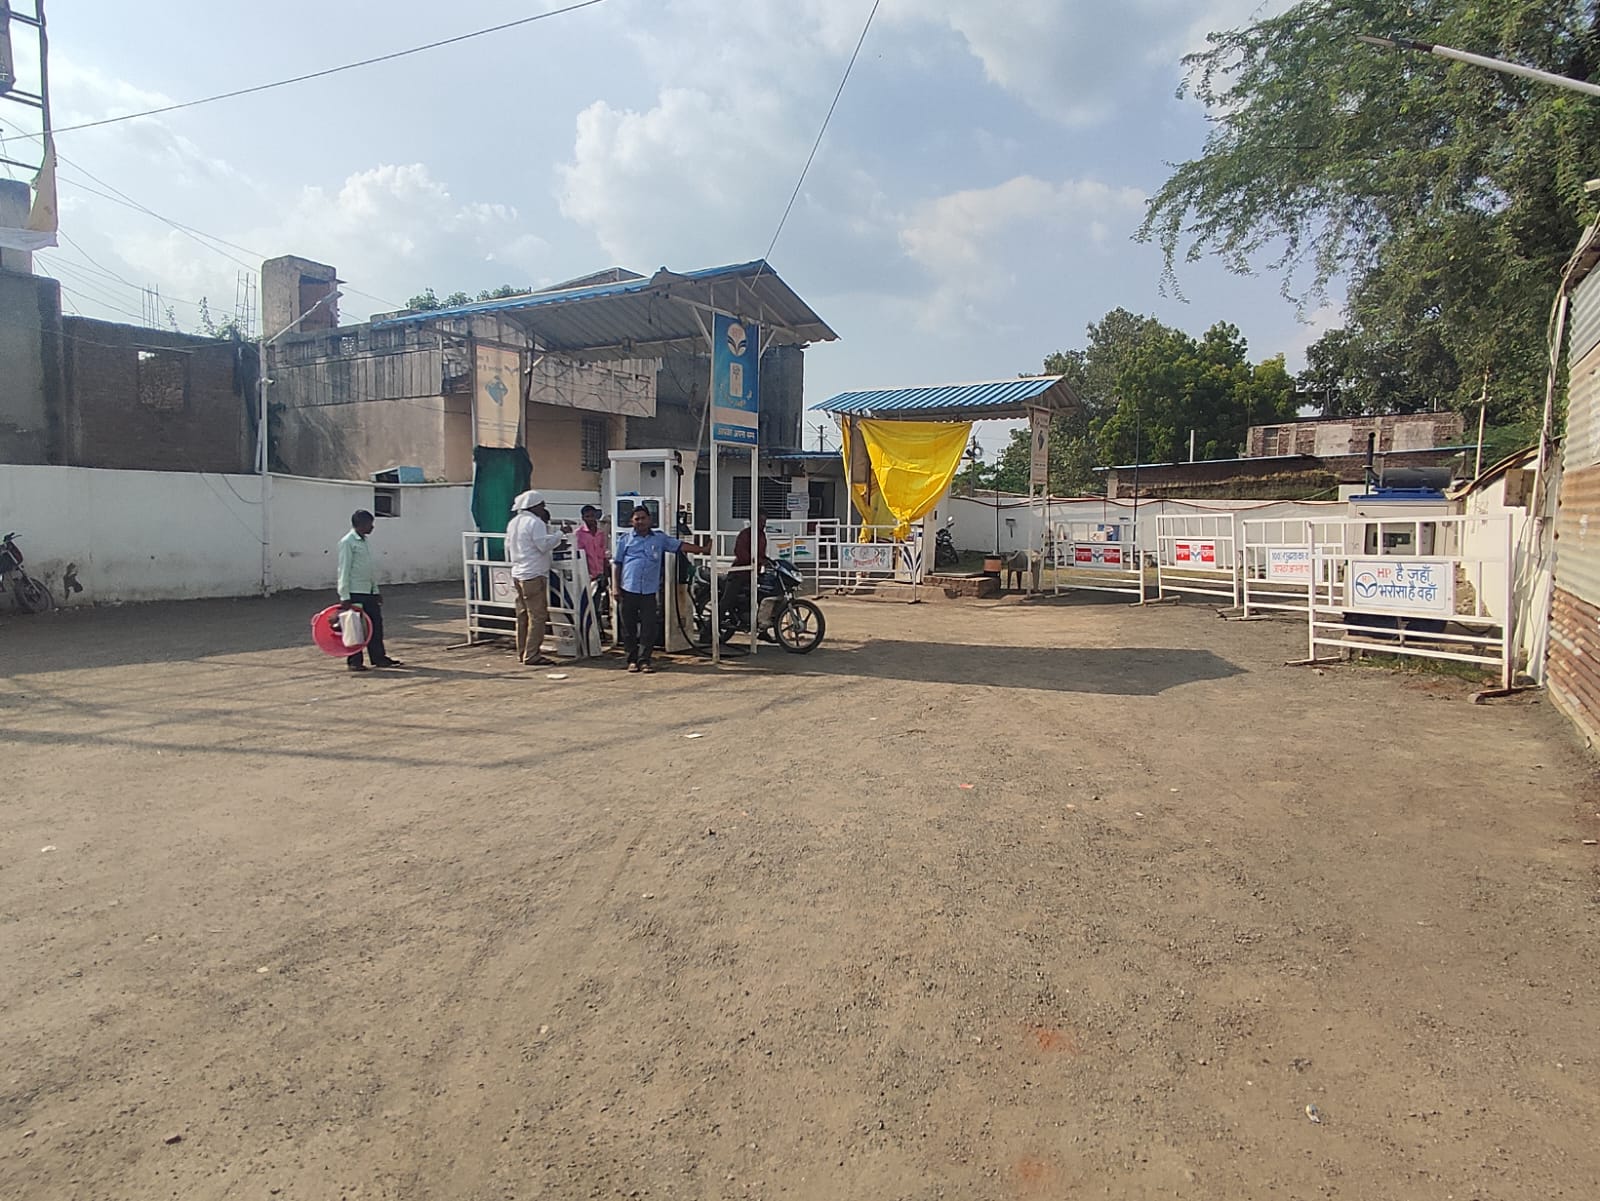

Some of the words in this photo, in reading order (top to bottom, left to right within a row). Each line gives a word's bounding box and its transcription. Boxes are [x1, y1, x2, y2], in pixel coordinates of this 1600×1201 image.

[1376, 567, 1392, 578] HP
[1395, 562, 1404, 581] है
[1407, 563, 1432, 583] जहाँ
[1378, 580, 1407, 599] भरोसा
[1407, 580, 1416, 601] है
[1417, 582, 1438, 602] वहाँ
